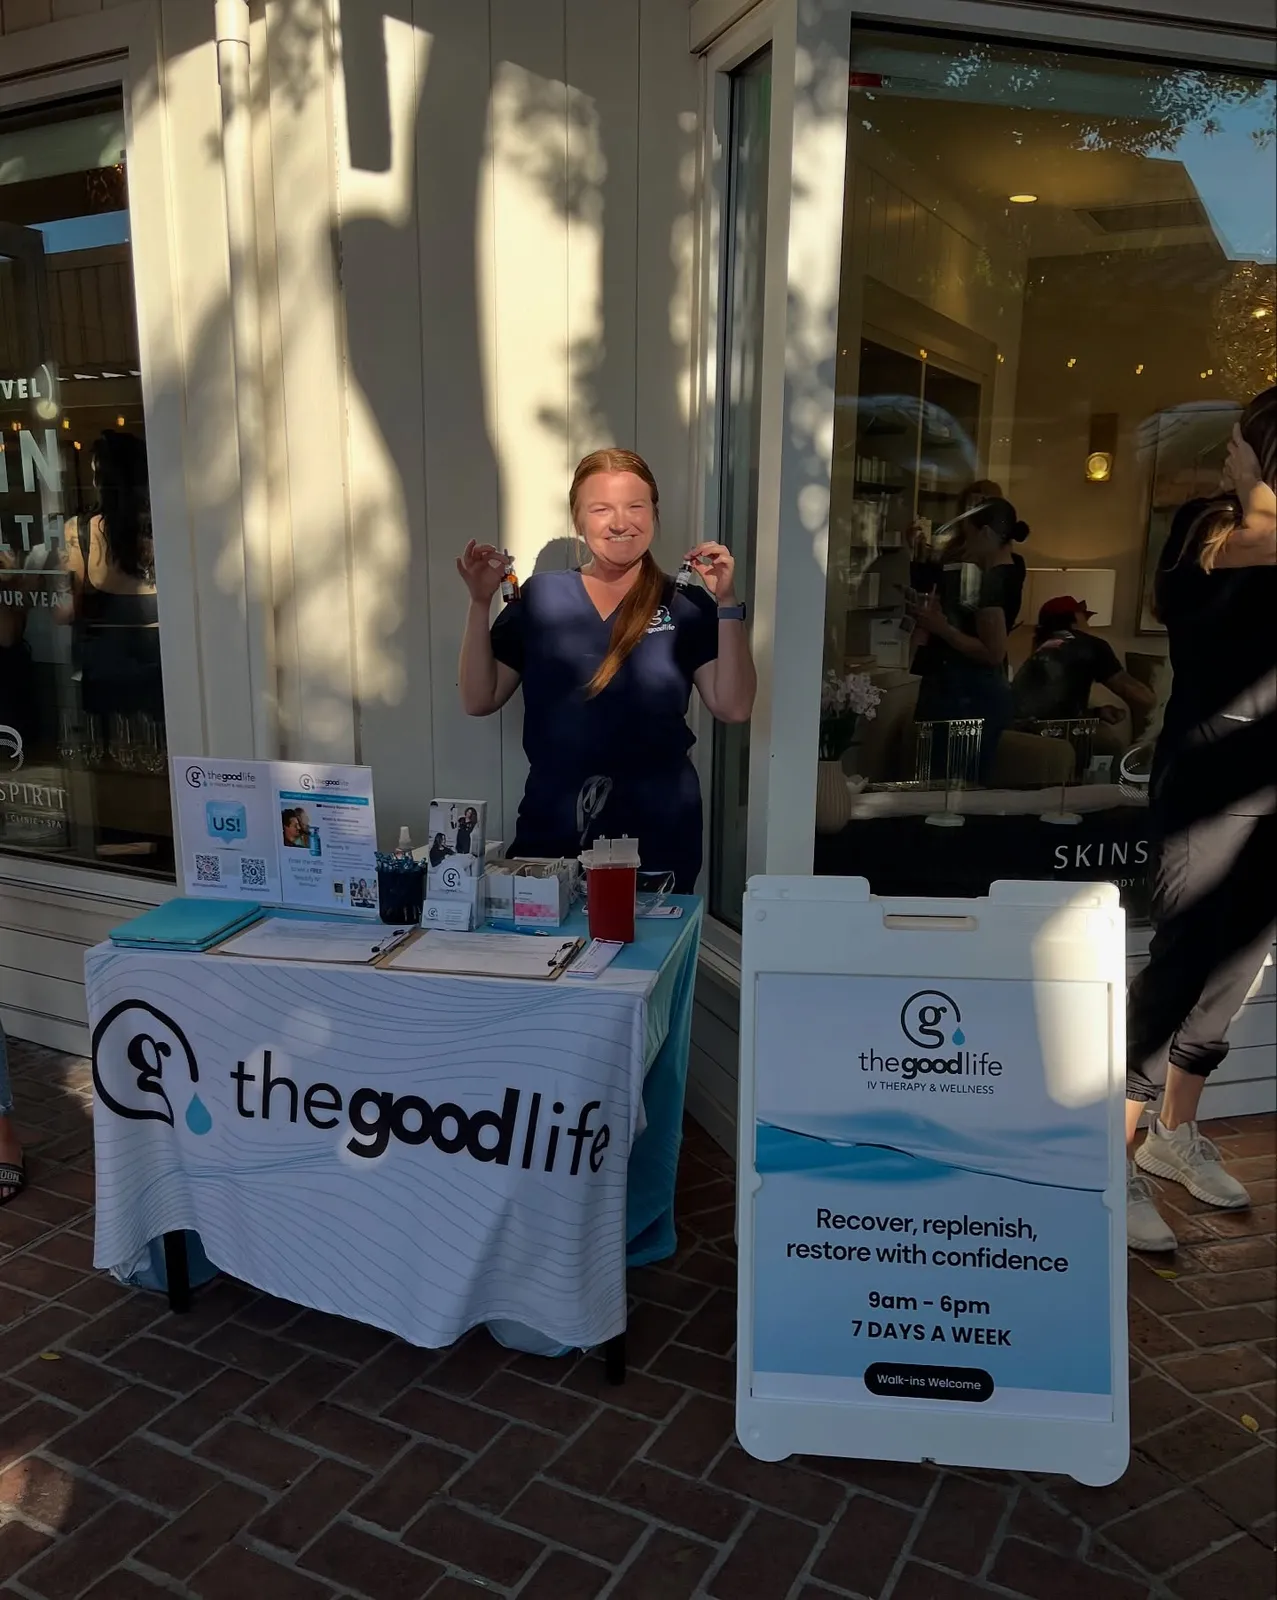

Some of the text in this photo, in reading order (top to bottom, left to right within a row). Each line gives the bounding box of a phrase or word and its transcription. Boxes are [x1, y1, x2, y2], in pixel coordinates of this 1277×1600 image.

[0, 590, 64, 609] UR YEA
[213, 817, 241, 833] US!
[858, 1048, 1003, 1080] thegoodlife
[867, 1081, 995, 1095] IV THERAPY & WELLNESS
[230, 1050, 611, 1177] thegoodlife
[816, 1208, 1038, 1243] Recover, replenish,
[786, 1241, 1070, 1274] restore with confidence
[868, 1291, 918, 1311] 9am
[940, 1295, 991, 1319] 6pm
[851, 1320, 1012, 1347] 7 DAYS A WEEK
[877, 1373, 982, 1391] Walk-ins Welcome
